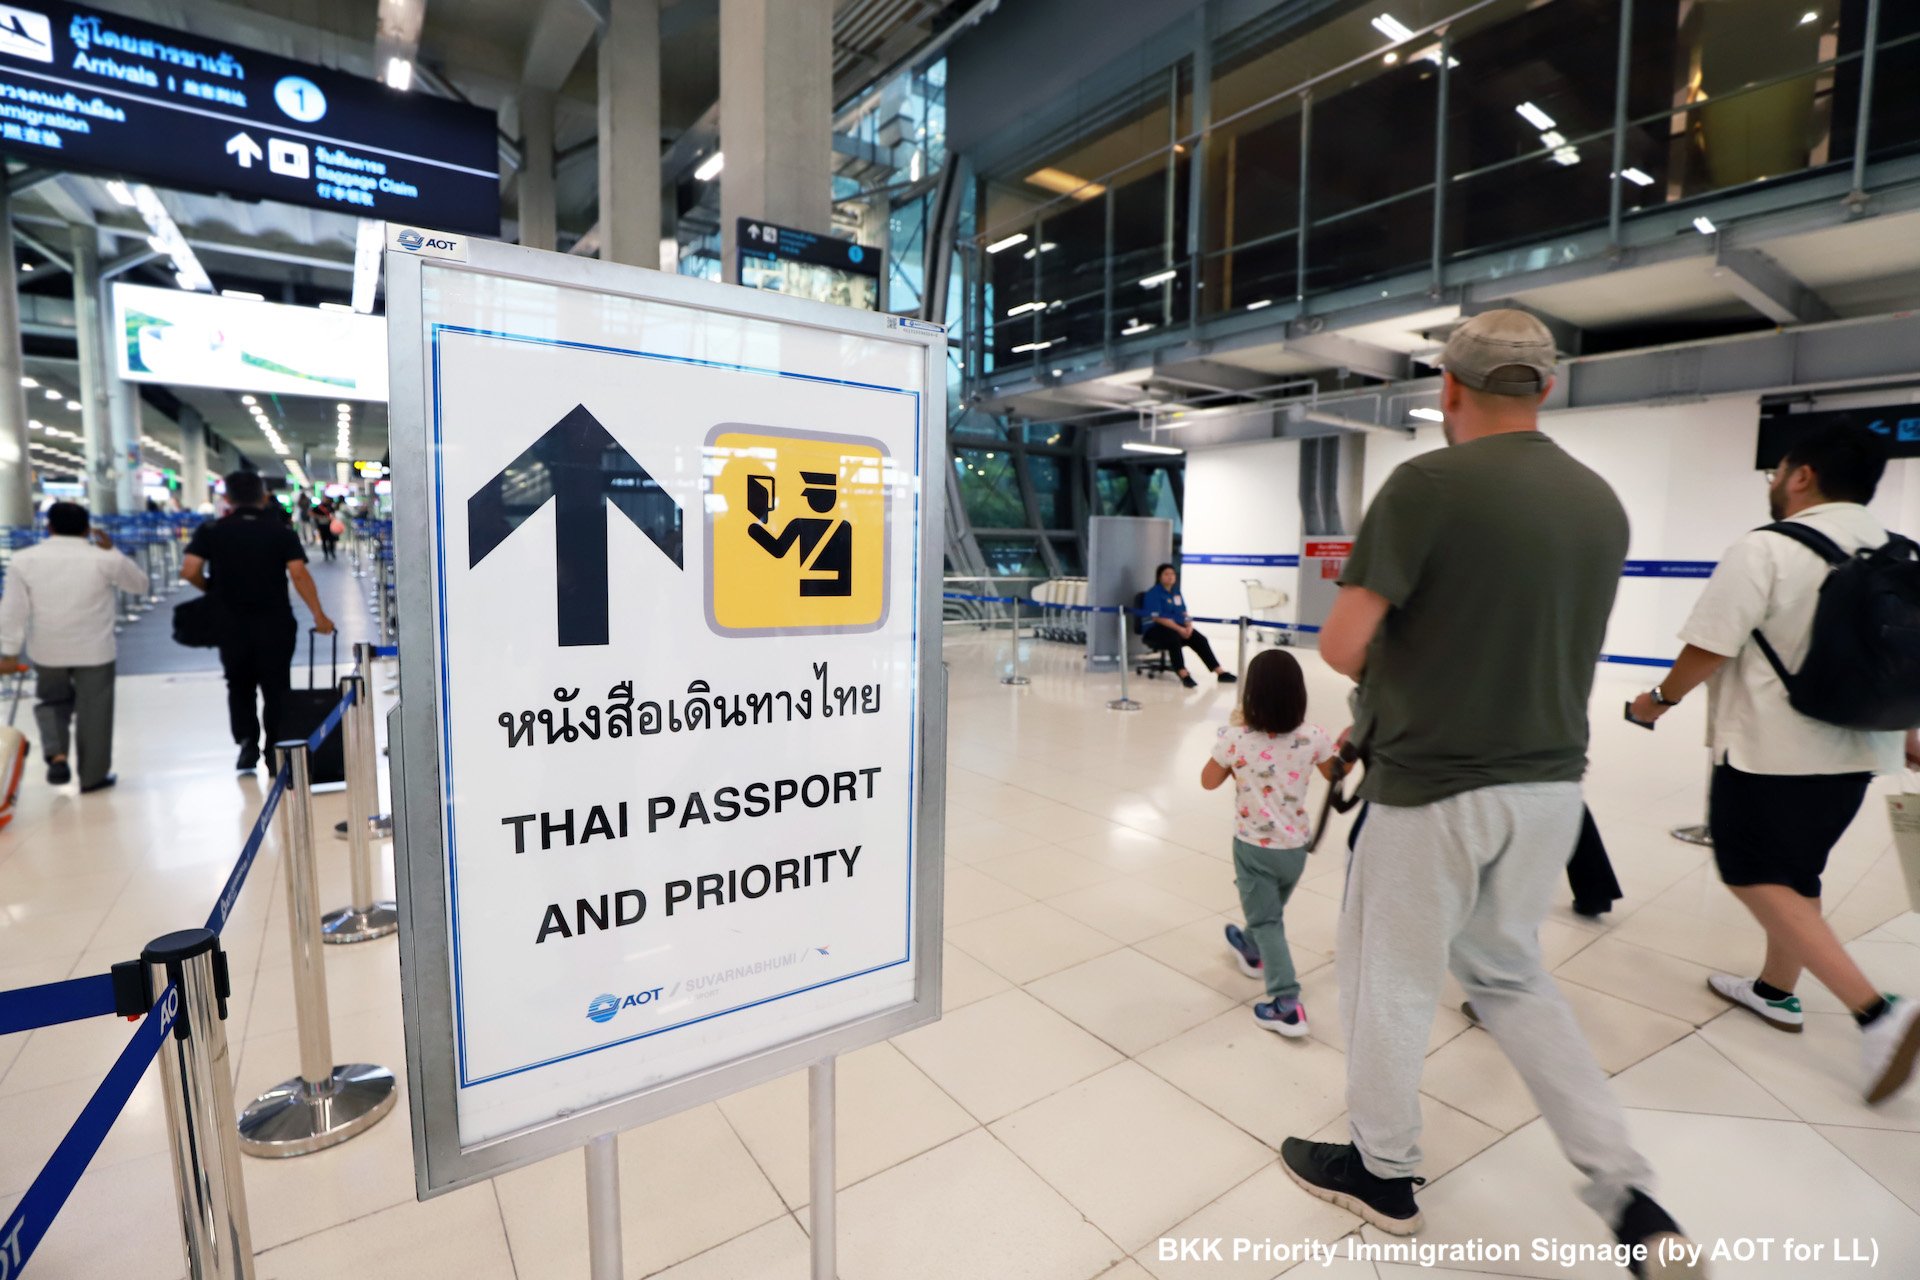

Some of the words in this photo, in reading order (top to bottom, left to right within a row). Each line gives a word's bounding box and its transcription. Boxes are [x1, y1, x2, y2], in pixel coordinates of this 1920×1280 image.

[73, 51, 159, 87] Arrivals
[379, 177, 418, 198] Claim
[426, 238, 457, 251] AOT
[499, 662, 881, 748] หนังสือเดินทางไทย
[502, 801, 628, 854] THAI
[649, 767, 882, 833] PASSPORT
[536, 889, 647, 944] AND
[666, 846, 862, 917] PRIORITY
[622, 987, 664, 1009] AOT
[685, 953, 796, 992] SUVARNABHUMI
[161, 984, 178, 1036] AO
